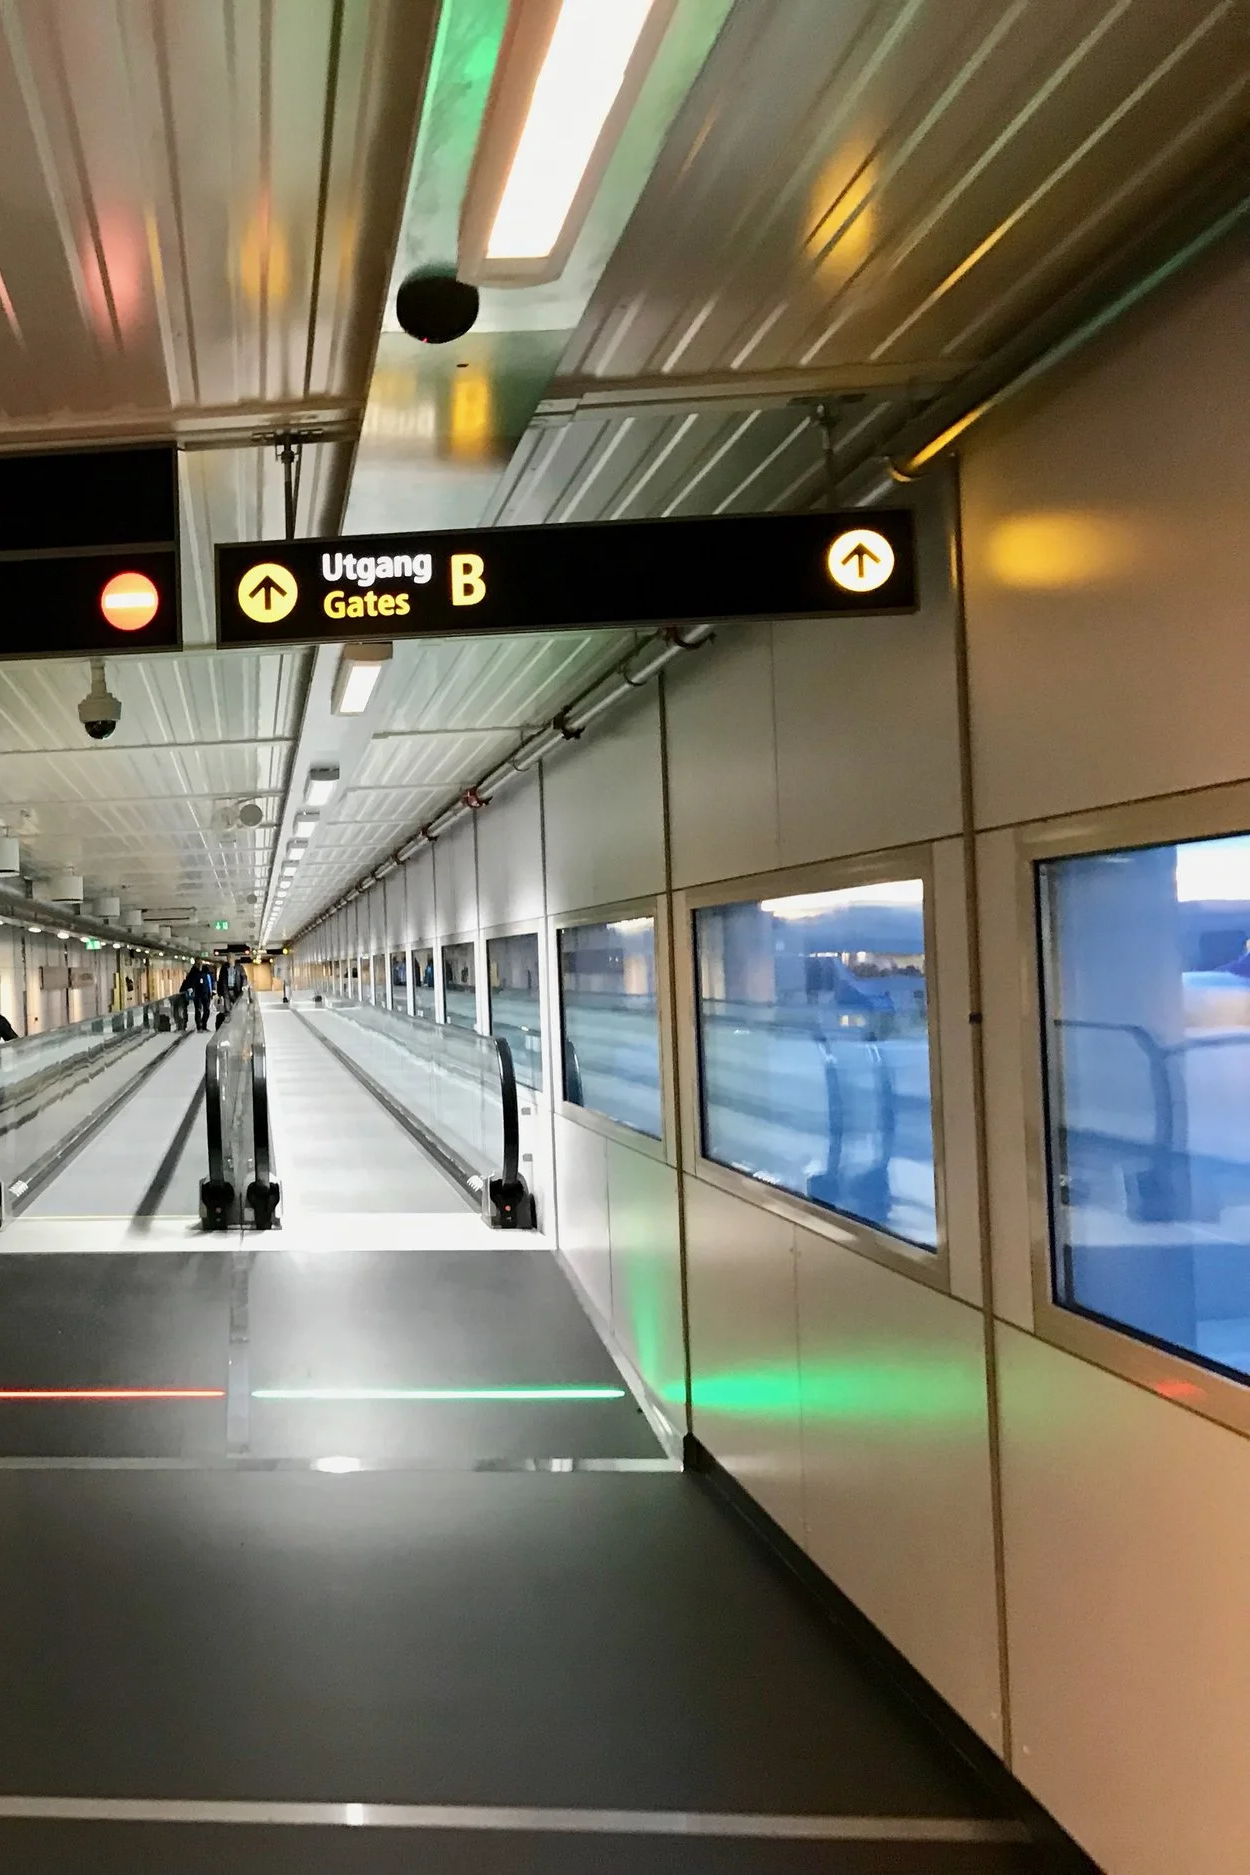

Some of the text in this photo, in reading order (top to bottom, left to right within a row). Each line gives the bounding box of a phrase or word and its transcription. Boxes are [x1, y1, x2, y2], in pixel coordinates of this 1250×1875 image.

[322, 552, 433, 588] Utgang
[450, 553, 487, 606] B
[323, 590, 411, 619] Gates
